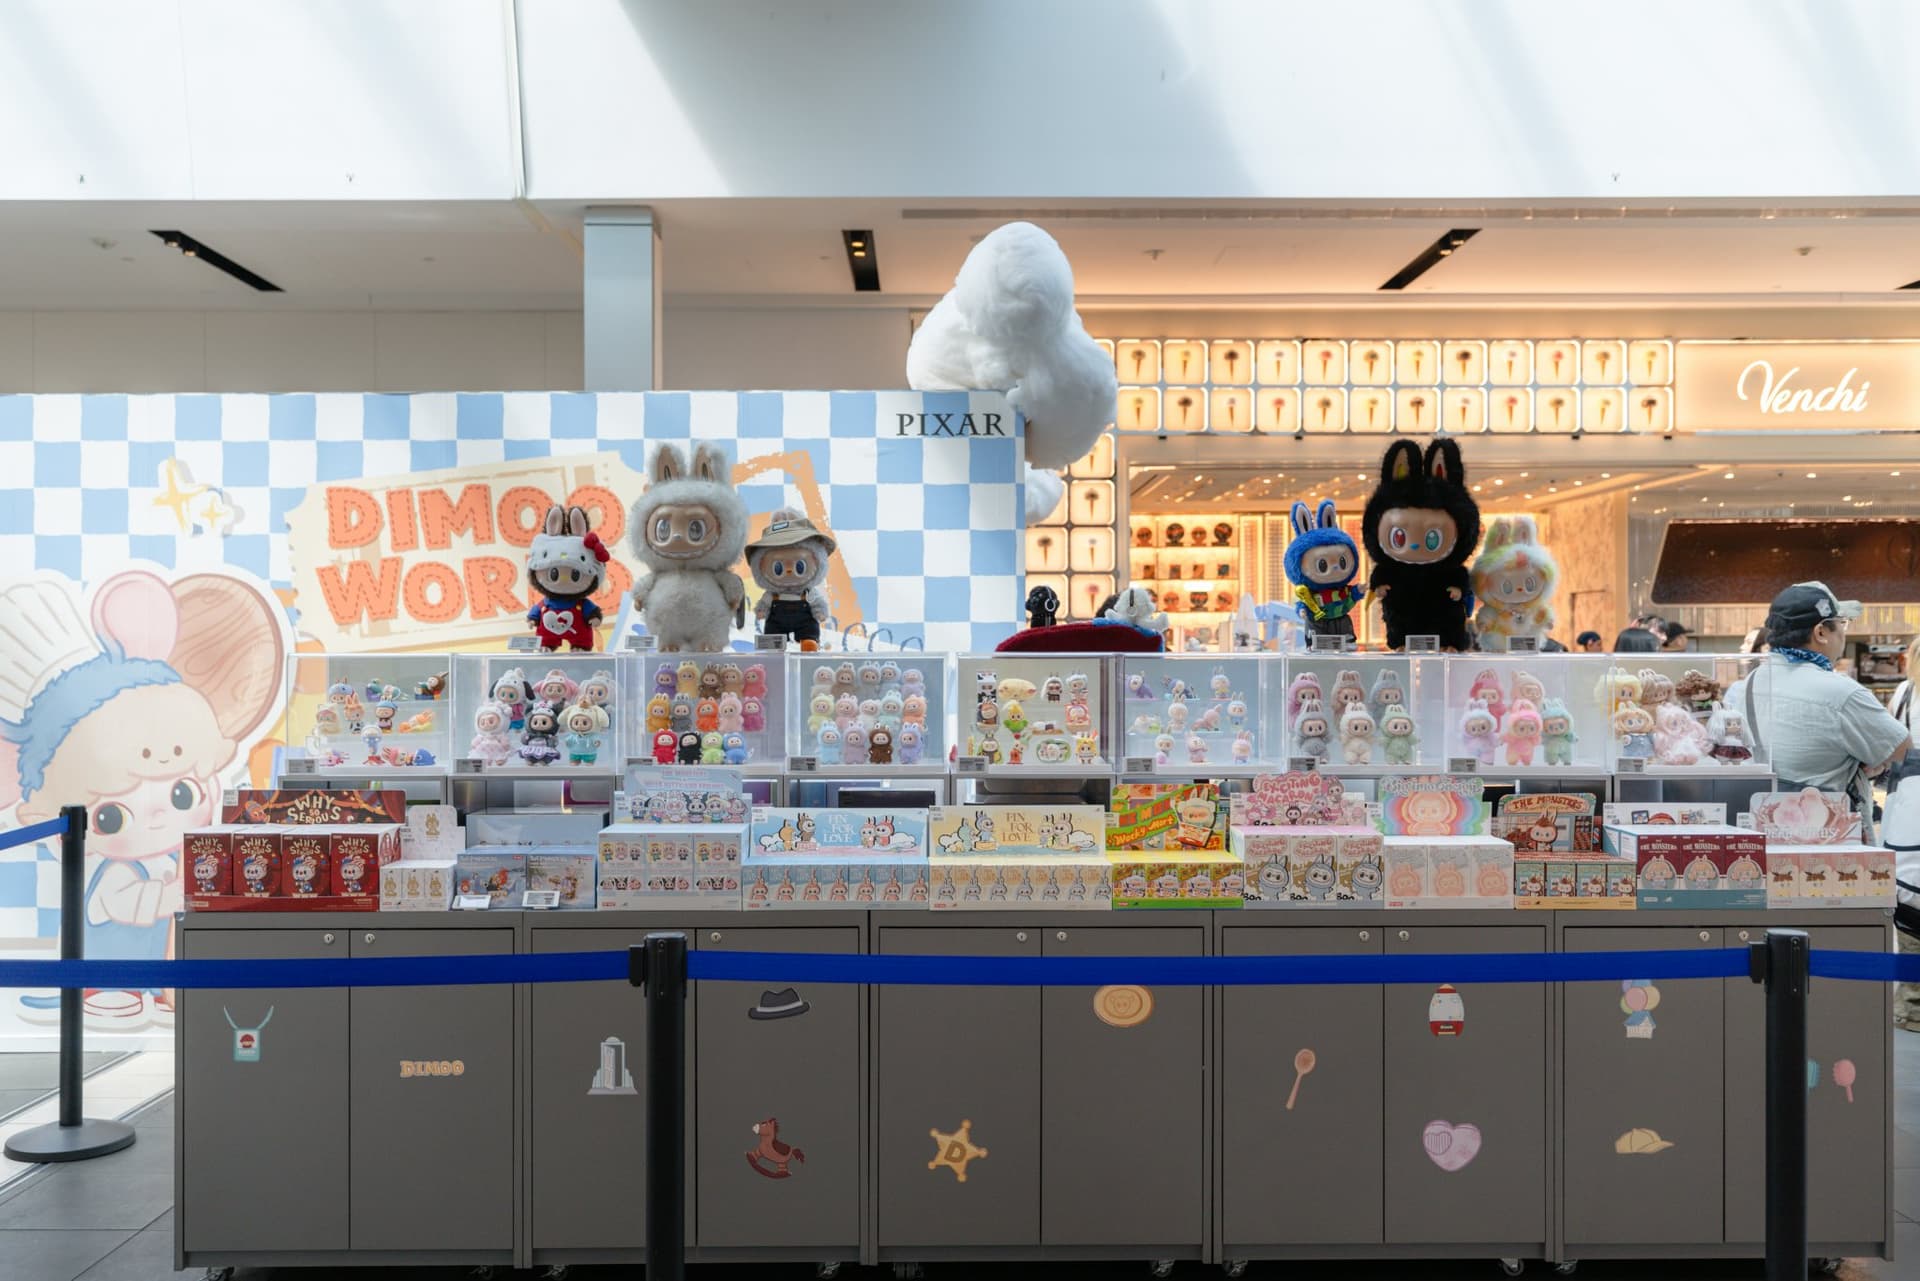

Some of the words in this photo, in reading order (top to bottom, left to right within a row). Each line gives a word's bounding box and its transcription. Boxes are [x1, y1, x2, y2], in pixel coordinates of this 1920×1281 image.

[1737, 360, 1871, 413] Venchi
[896, 413, 1006, 437] PIXAR
[326, 483, 626, 552] DIMOO
[294, 794, 335, 810] WHY
[1512, 798, 1533, 809] THE
[1537, 796, 1583, 810] MONSTERS
[287, 806, 341, 824] SERIOUS
[1010, 822, 1034, 833] FOR
[823, 833, 854, 843] LOVE
[1002, 832, 1031, 842] LOVE
[400, 1060, 464, 1078] DIMOO
[944, 1140, 966, 1163] D
